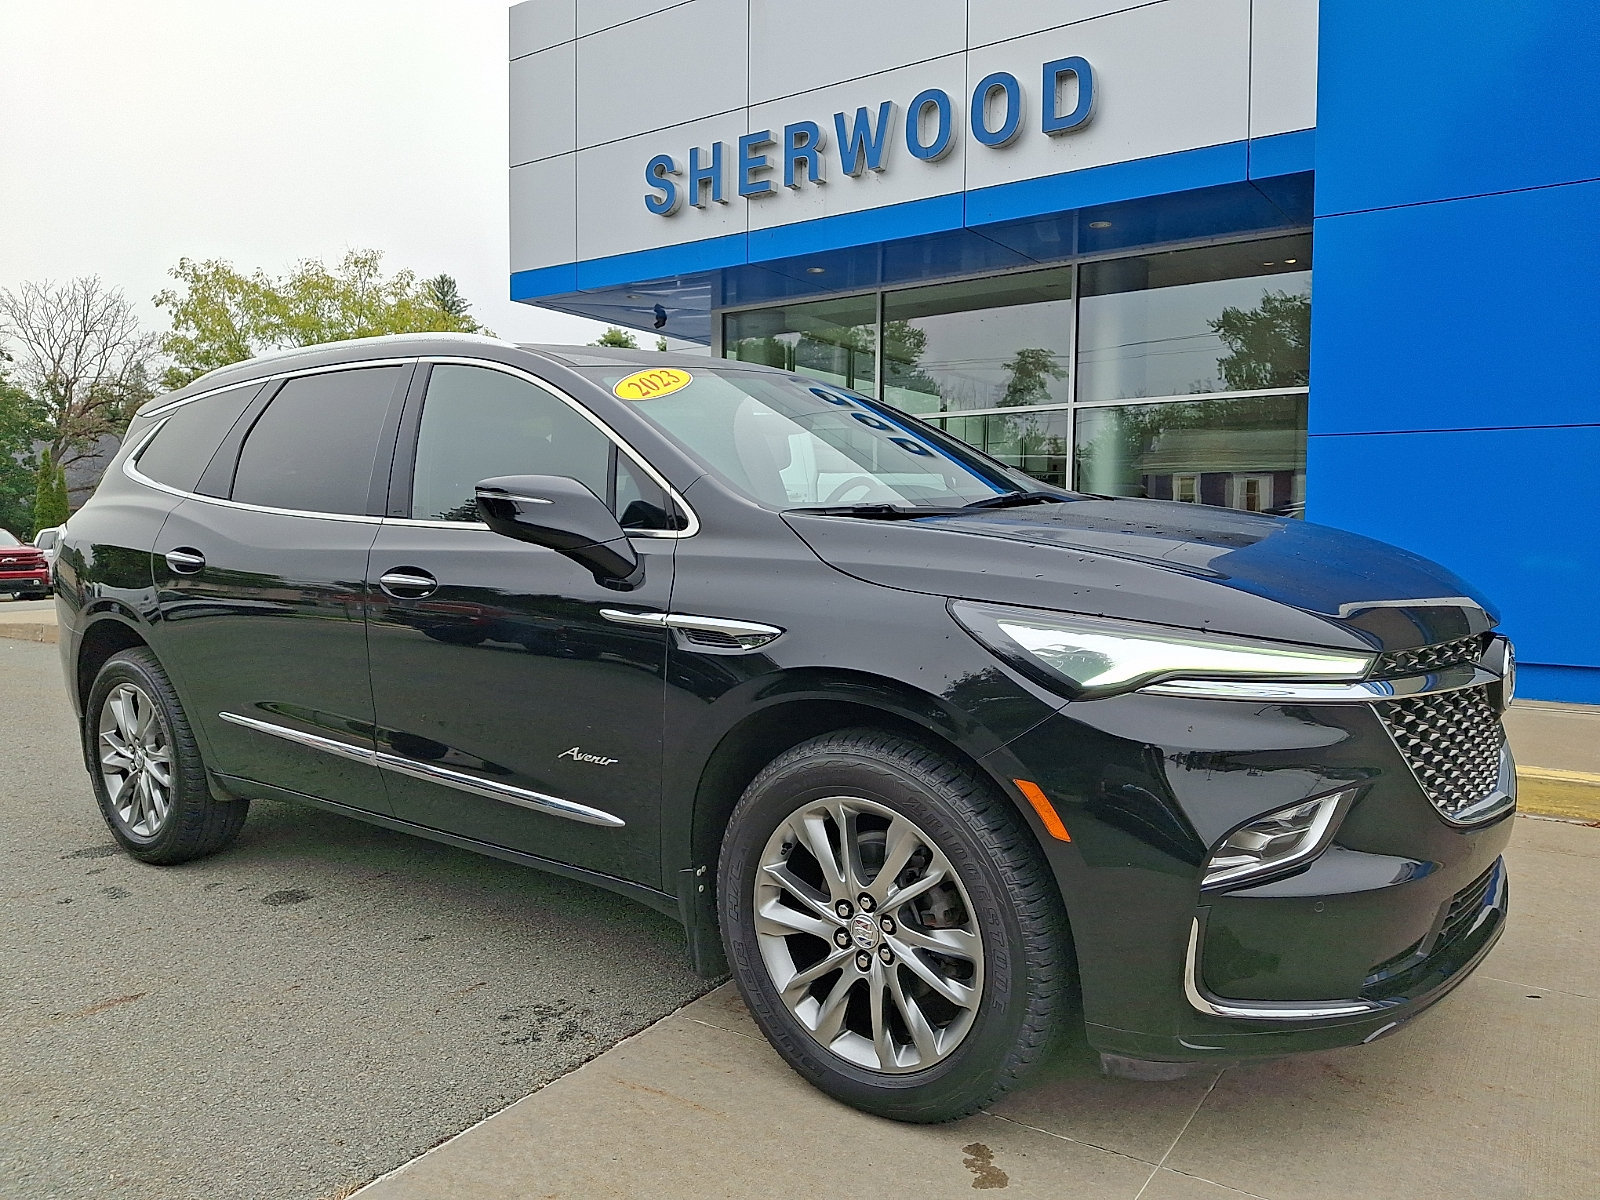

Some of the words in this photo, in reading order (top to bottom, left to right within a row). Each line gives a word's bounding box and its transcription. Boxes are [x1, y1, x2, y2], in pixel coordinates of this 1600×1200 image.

[644, 55, 1096, 217] SHERWOOD
[627, 369, 681, 397] 2023
[557, 746, 619, 766] Avenir
